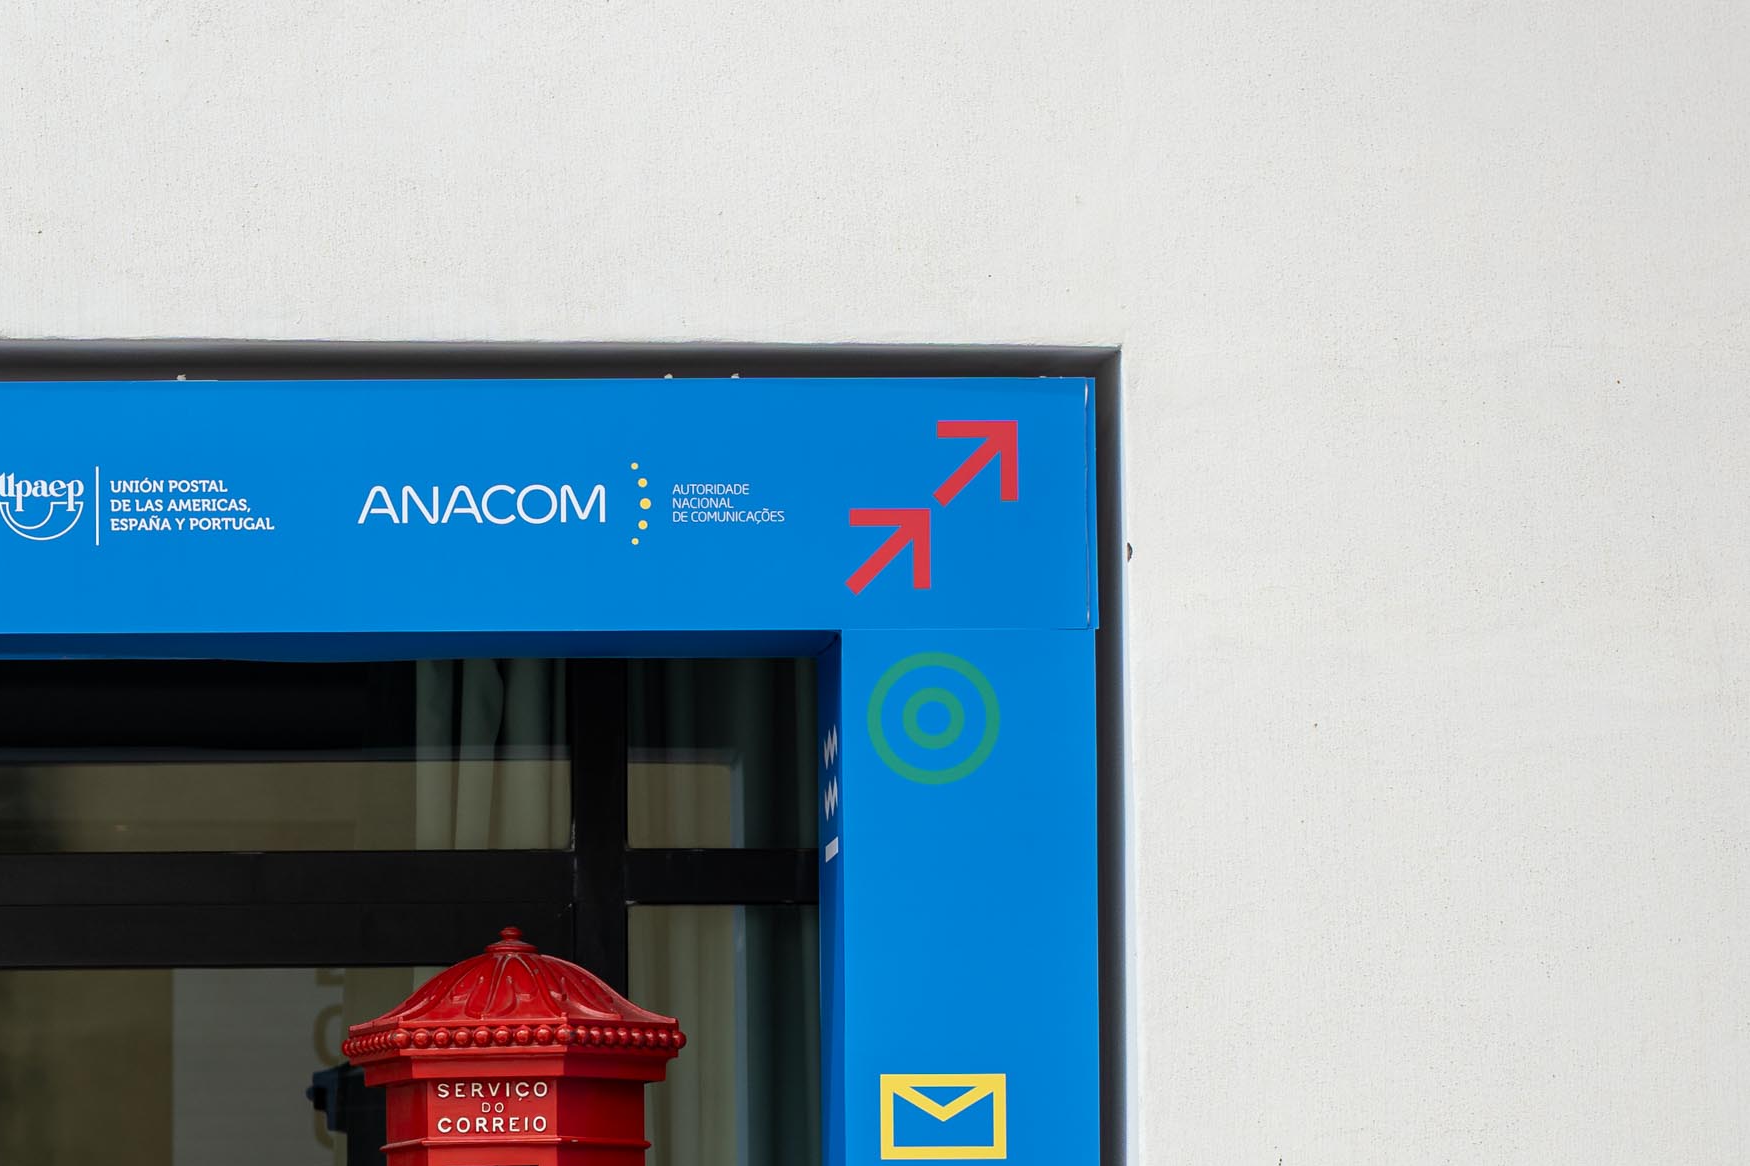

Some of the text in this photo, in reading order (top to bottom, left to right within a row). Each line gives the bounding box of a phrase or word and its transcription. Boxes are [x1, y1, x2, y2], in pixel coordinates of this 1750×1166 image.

[110, 477, 228, 493] UNIÓN POSTAL
[673, 484, 749, 495] AUTORIDADE
[110, 498, 250, 512] DE LAS AMERICAS,
[358, 484, 605, 524] ANACOM
[673, 498, 734, 508] NACIONAL
[110, 515, 274, 531] ESPAÑA Y PORTUGAL
[673, 507, 785, 524] DE COMUNICAÇÕES
[437, 1081, 548, 1102] SERVIÇO
[482, 1102, 505, 1113] DO
[437, 1116, 547, 1133] CORREIO
